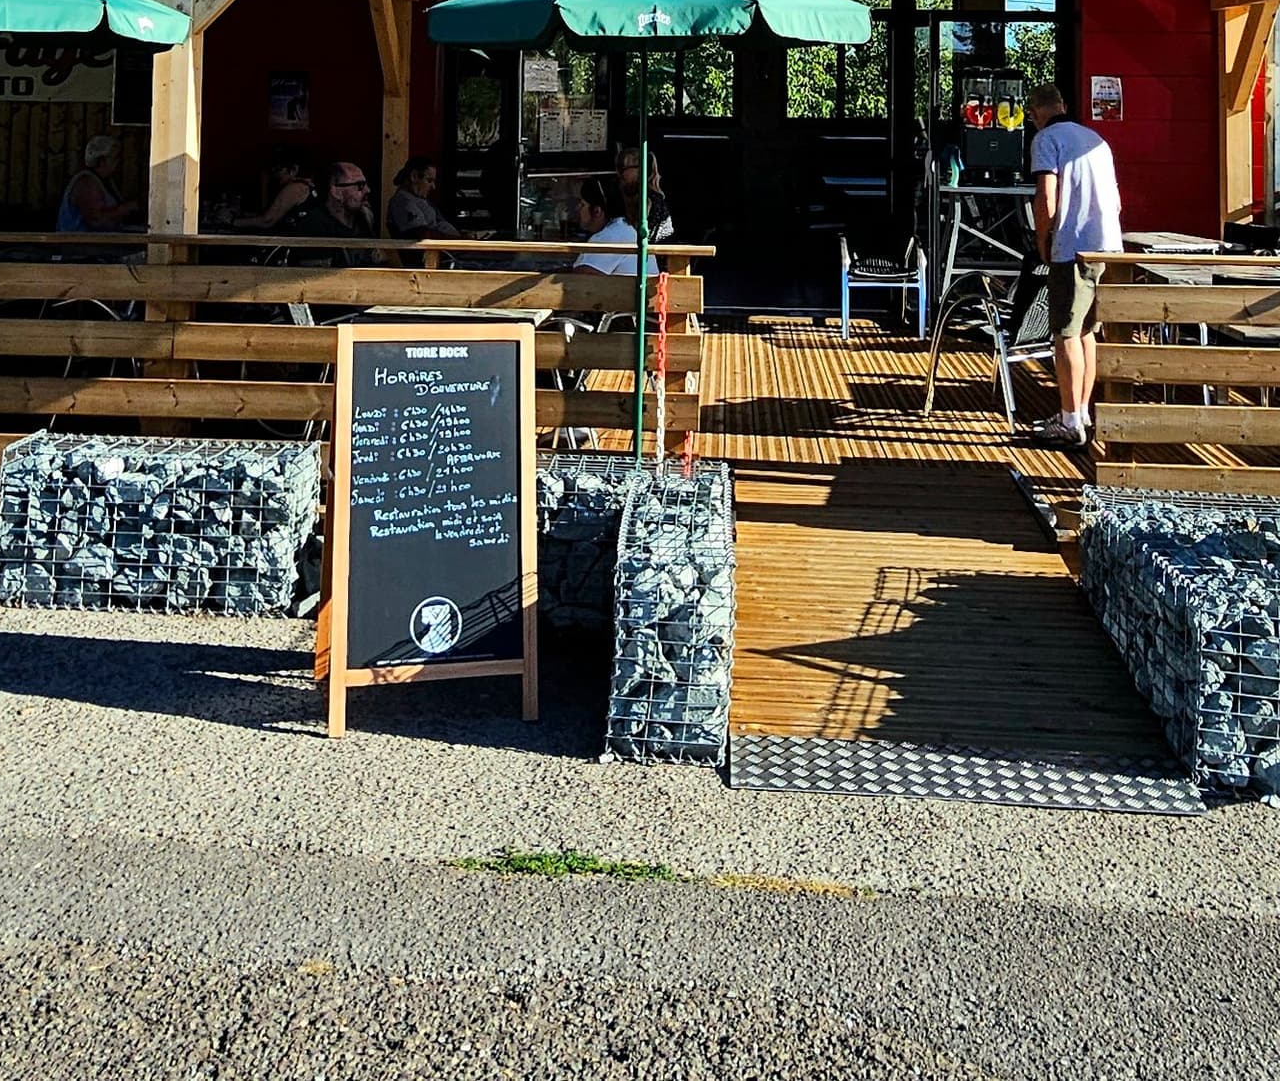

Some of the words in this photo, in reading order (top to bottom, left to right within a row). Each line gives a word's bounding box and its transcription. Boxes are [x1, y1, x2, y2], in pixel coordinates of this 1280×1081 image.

[405, 346, 438, 359] TIGRE
[439, 346, 469, 358] BOCK
[373, 505, 441, 521] Restauration
[369, 519, 435, 538] Restauration
